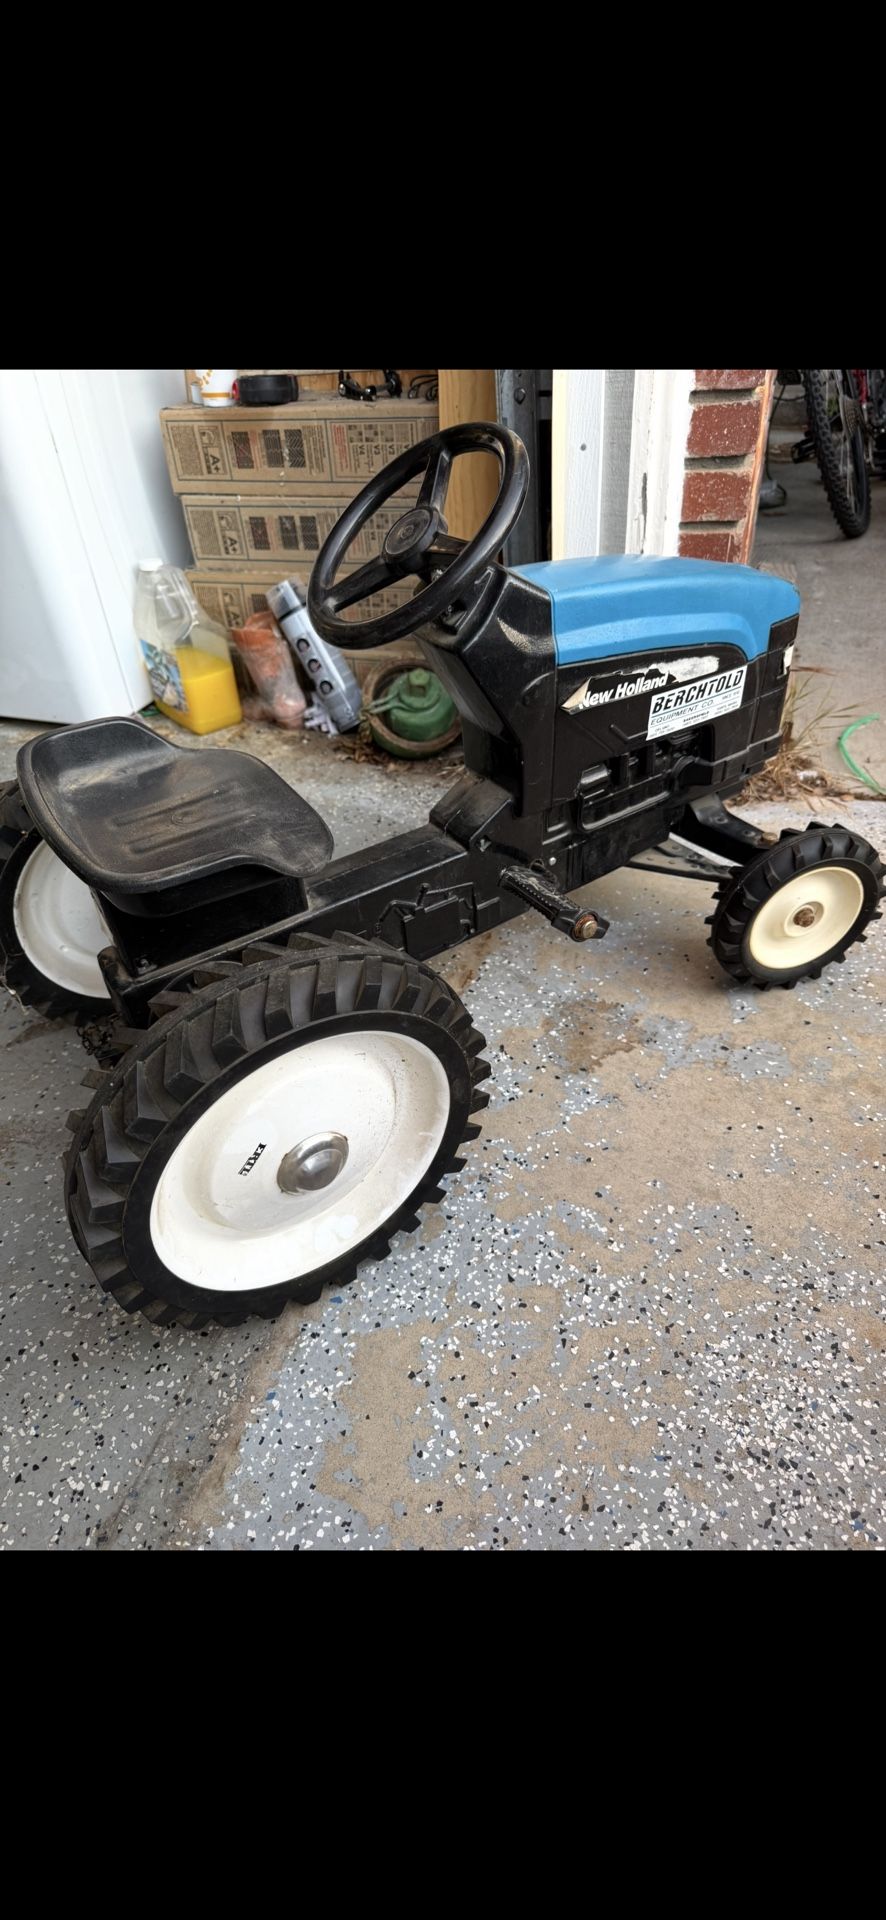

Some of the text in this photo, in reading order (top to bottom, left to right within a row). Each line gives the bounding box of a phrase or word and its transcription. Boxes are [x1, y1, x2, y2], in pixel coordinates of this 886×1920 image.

[209, 454, 221, 474] A+
[227, 536, 239, 554] A+
[578, 671, 670, 710] New Holland
[651, 669, 744, 715] BERCHTOLD
[650, 704, 700, 726] EQUIPMENT
[238, 1142, 267, 1176] ERTL
